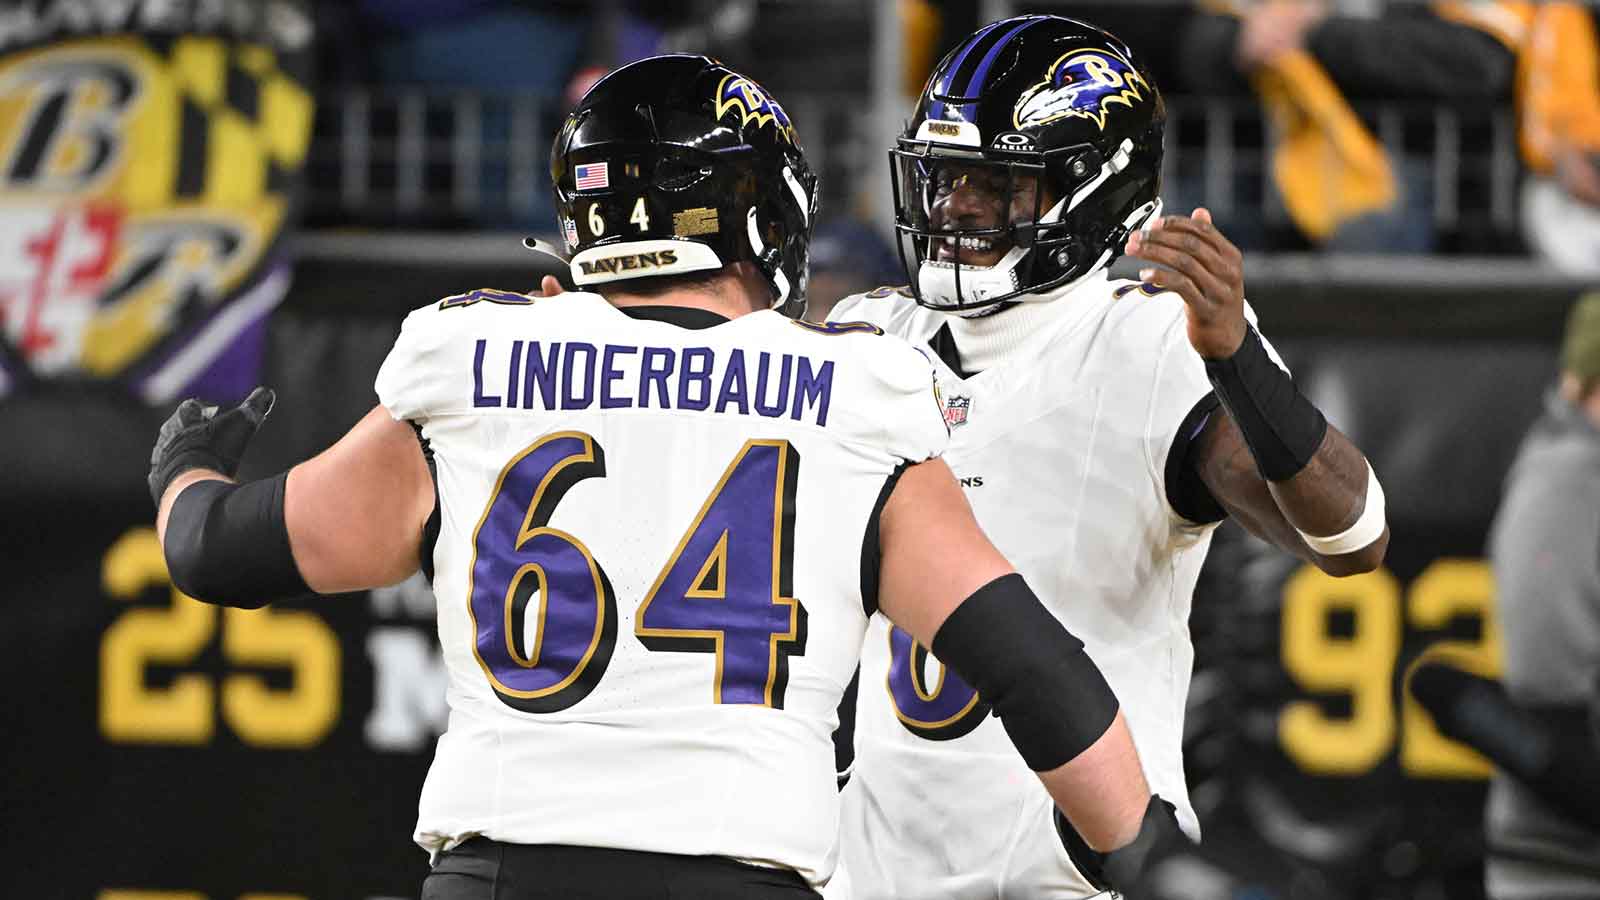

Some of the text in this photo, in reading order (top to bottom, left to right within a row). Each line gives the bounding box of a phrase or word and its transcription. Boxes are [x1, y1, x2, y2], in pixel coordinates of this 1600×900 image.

[993, 143, 1036, 152] OAKLEY
[579, 250, 678, 275] RAVENS
[472, 339, 835, 427] LINDERBAUM
[468, 430, 808, 714] 64
